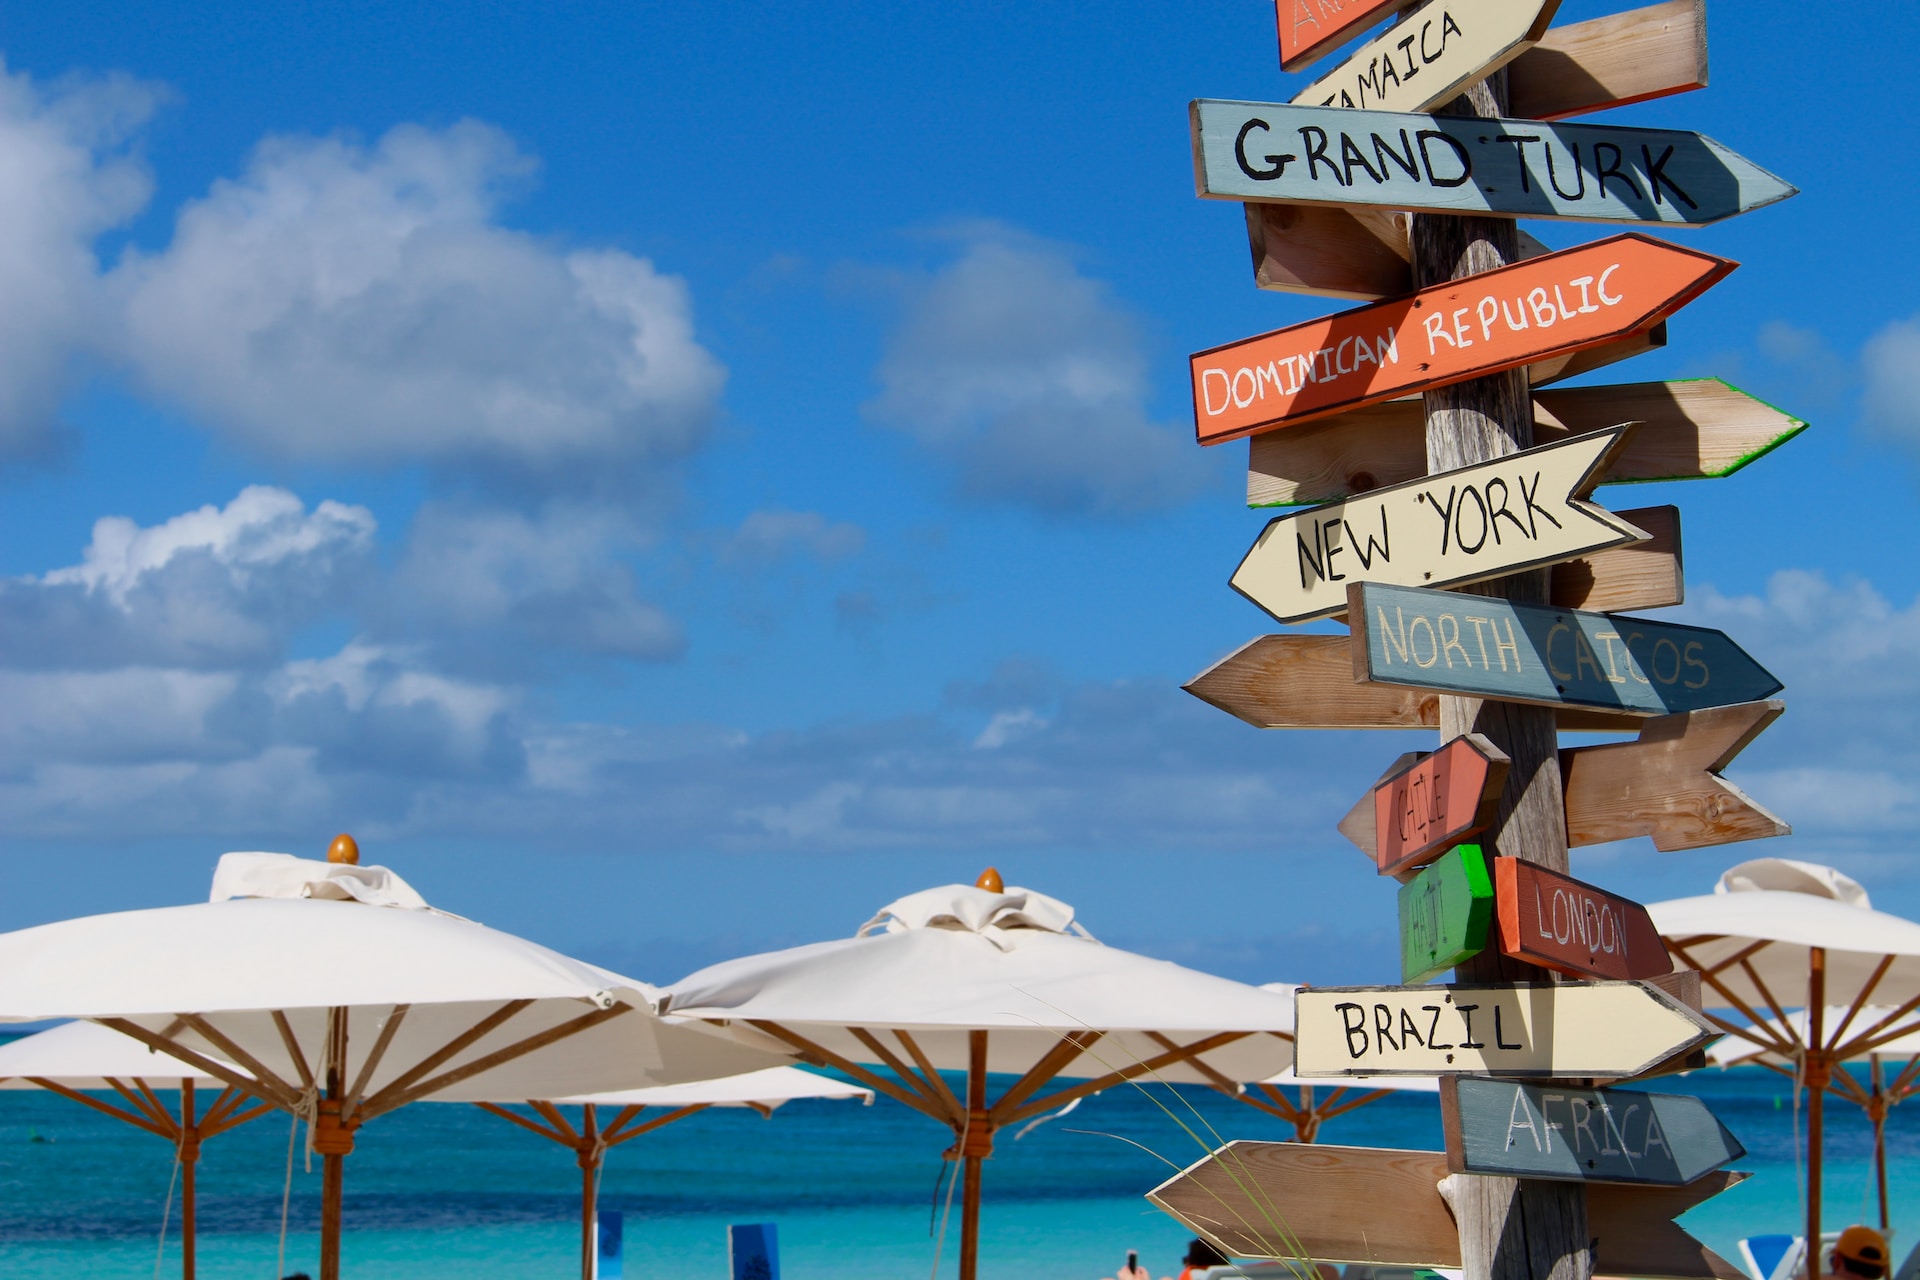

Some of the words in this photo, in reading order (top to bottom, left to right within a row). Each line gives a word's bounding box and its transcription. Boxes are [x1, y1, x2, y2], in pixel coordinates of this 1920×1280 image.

[1235, 118, 1472, 188] GRAND
[1496, 134, 1699, 210] TURK
[1201, 326, 1399, 416] DOMINICAN
[1422, 264, 1624, 356] REPUBLIC
[1296, 504, 1391, 590] NEW
[1425, 470, 1563, 556] YORK
[1377, 605, 1522, 674] NORTH
[1546, 623, 1710, 689] CAICOS
[1397, 774, 1445, 842] CHILE
[1535, 883, 1628, 958] LONDON
[1335, 1002, 1523, 1059] BRAZIL
[1505, 1085, 1672, 1160] AFRICA
